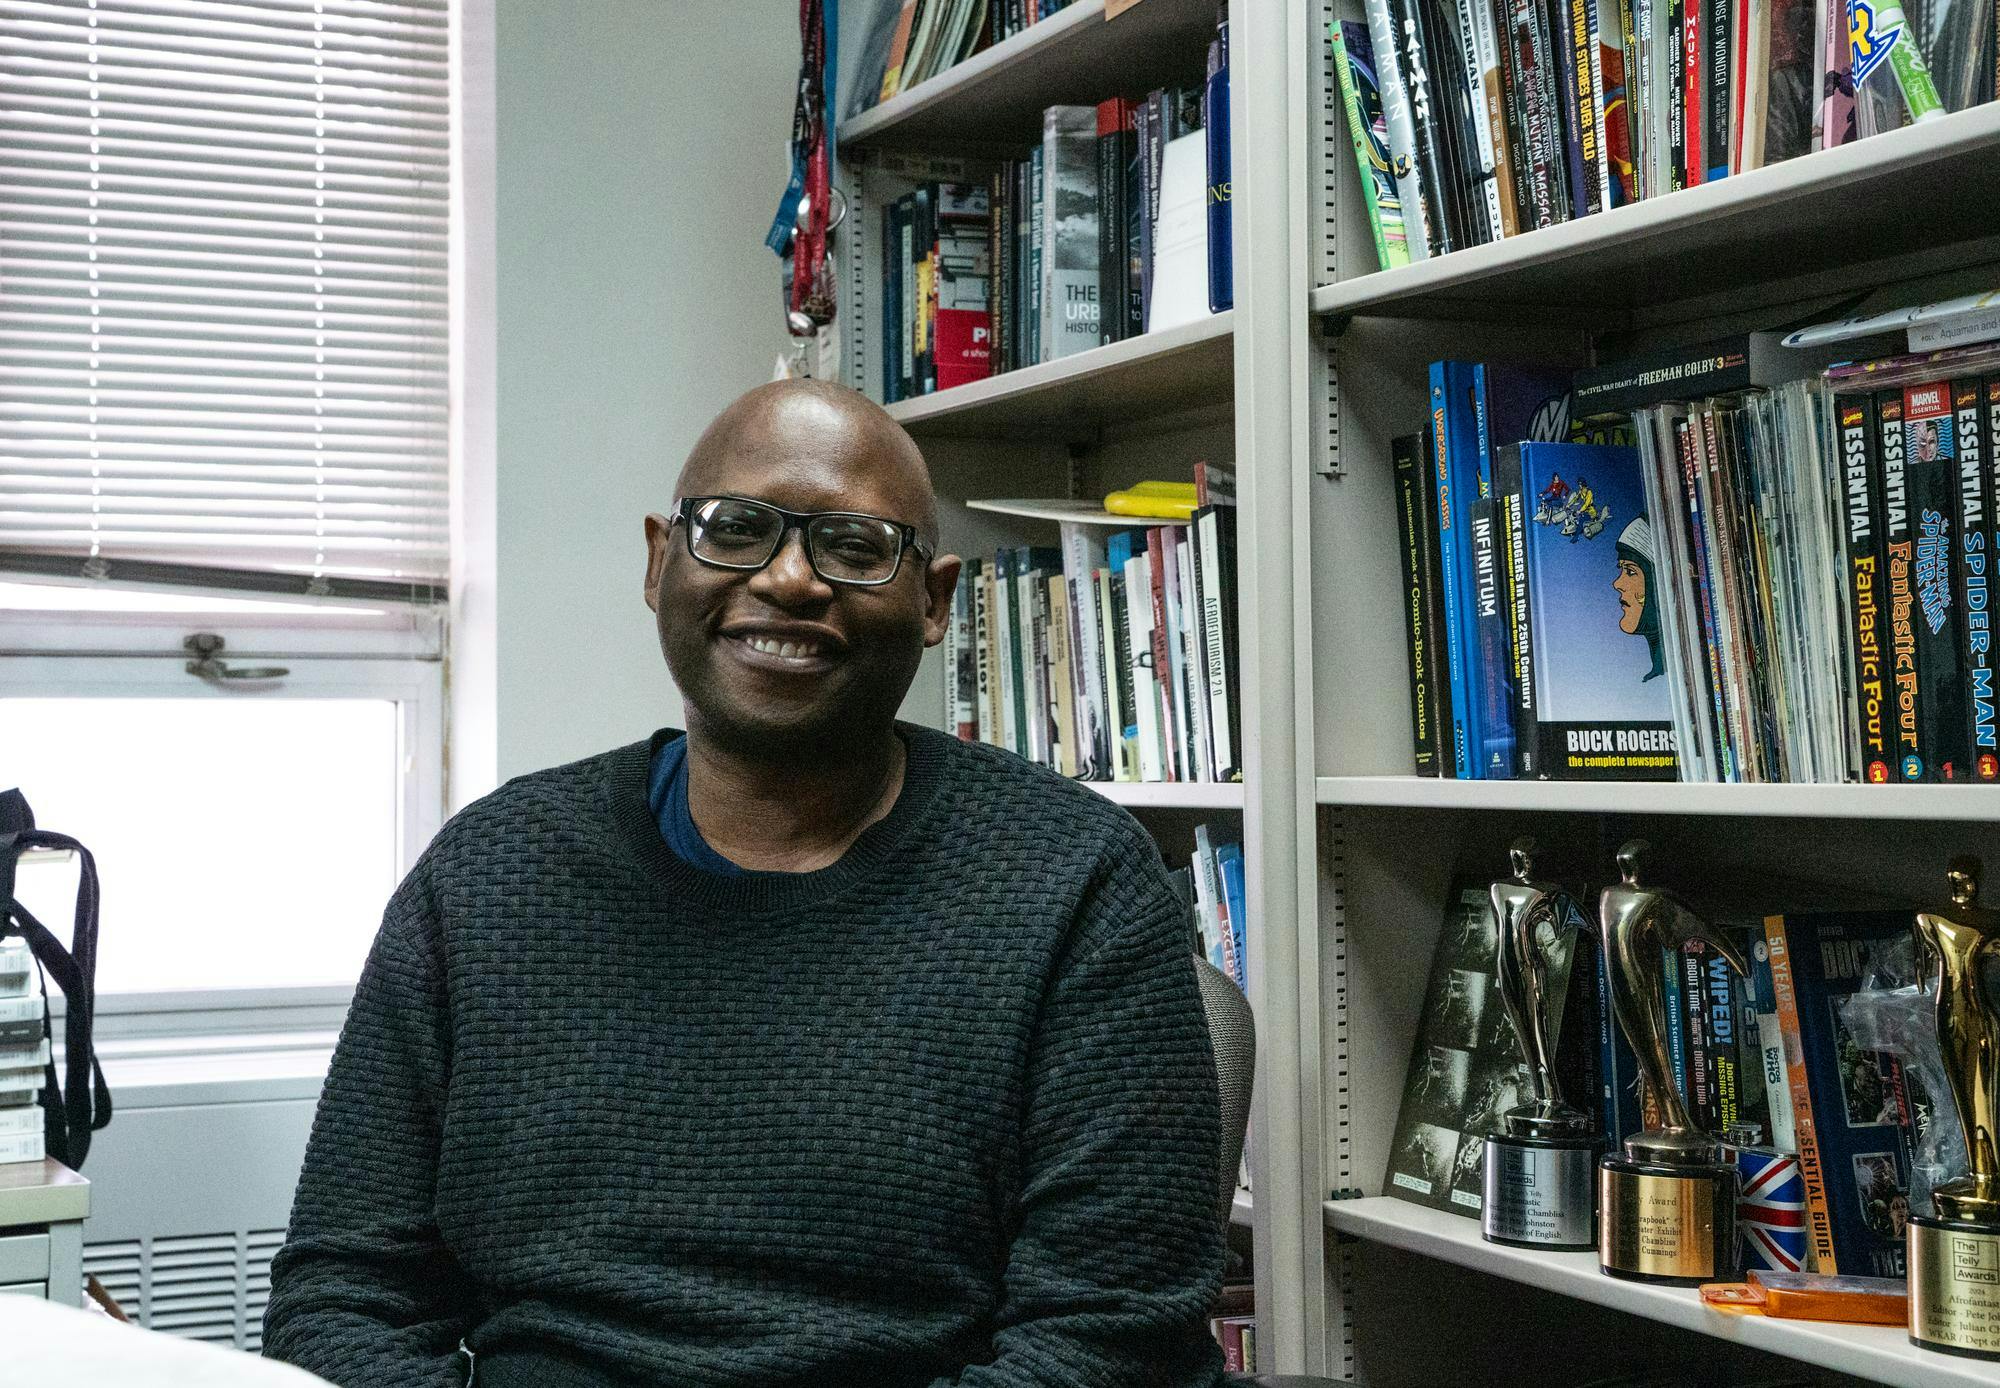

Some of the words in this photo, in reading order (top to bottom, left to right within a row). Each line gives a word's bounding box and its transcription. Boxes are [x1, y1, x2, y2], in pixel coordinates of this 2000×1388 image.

[1511, 17, 1519, 35] RED
[1572, 0, 1588, 47] BATMAN
[1641, 10, 1652, 41] COMICS
[1715, 0, 1727, 23] NSE
[1513, 40, 1521, 51] NO
[1686, 16, 1698, 68] MAUS
[1715, 25, 1725, 36] OF
[1336, 50, 1350, 91] SUPERMAN
[1403, 19, 1430, 119] BATMAN
[1515, 52, 1525, 83] QUARTER
[1575, 48, 1591, 97] STORIES
[1715, 38, 1727, 87] WONDER
[1506, 92, 1517, 127] JOYRIDE
[1579, 98, 1594, 129] EVER
[1512, 142, 1522, 171] DIGGLE
[1528, 114, 1545, 168] MUTANT
[1582, 131, 1597, 161] TOLD
[1150, 137, 1159, 189] Rebuilding
[1151, 189, 1159, 219] Urban
[1516, 175, 1526, 206] MANCO
[1065, 284, 1097, 302] THE
[1940, 324, 1980, 341] Aquaman
[1980, 318, 1997, 332] and
[1602, 382, 1615, 393] WAR
[1614, 378, 1633, 391] DIARY
[1638, 365, 1683, 386] FREEMAN
[1684, 358, 1715, 378] COLBY
[1716, 356, 1724, 370] 3
[1910, 391, 1940, 407] MARVEL
[1910, 404, 1941, 415] ESSENTIAL
[1475, 400, 1485, 433] JAMAL
[1433, 407, 1449, 482] UNDERGROUND
[1478, 435, 1487, 457] IGLE
[1884, 420, 1908, 536] ESSENTIAL
[1957, 408, 1984, 527] ESSENTIAL
[1844, 426, 1871, 543] ESSENTIAL
[1405, 488, 1418, 547] Smithsonian
[1440, 484, 1451, 531] CLASSICS
[1509, 493, 1521, 528] BUCK
[1411, 548, 1419, 571] Book
[1474, 516, 1497, 618] INFINITUM
[1506, 540, 1516, 577] newspaper
[1512, 530, 1525, 583] ROGERS
[1917, 507, 1945, 636] SPIDER-MAN
[1934, 532, 1954, 608] AMAZING
[1412, 573, 1420, 585] of
[976, 586, 990, 642] RACE
[1516, 597, 1527, 622] the
[1854, 555, 1880, 675] Fantastic
[1888, 540, 1916, 669] Fantastic
[1205, 596, 1222, 677] AFROFUTURISM
[1411, 587, 1427, 680] Comic-Book
[1518, 623, 1530, 655] 25th
[1962, 530, 1997, 747] SPIDER-MAN
[978, 647, 989, 696] RIOT
[1520, 657, 1532, 709] Century
[1212, 679, 1223, 697] 2.0
[1417, 683, 1429, 741] Comics
[1864, 675, 1885, 752] Four
[1897, 669, 1918, 749] Four
[1566, 730, 1615, 752] BUCK
[1616, 730, 1680, 752] ROGERS
[1568, 755, 1584, 767] the
[1584, 755, 1626, 768] complete
[1626, 755, 1675, 768] newspaper
[1873, 769, 1884, 783] 1
[1907, 764, 1918, 776] 2
[1942, 762, 1953, 779] 1
[1983, 763, 1994, 776] 1
[1769, 935, 1784, 957] 50
[1686, 958, 1698, 988] ABOUT
[1774, 961, 1793, 1013] YEARS
[1598, 976, 1608, 1014] DOCTOR
[1668, 995, 1680, 1025] British
[1689, 988, 1701, 1012] TIME
[1708, 955, 1734, 1045] WIPED!
[1600, 1019, 1609, 1045] WHO
[1671, 1026, 1682, 1060] Science
[1693, 1050, 1704, 1082] DOCTOR
[1718, 1056, 1728, 1095] MISSING
[1764, 1046, 1775, 1084] WHO
[1772, 1046, 1782, 1082] DOCTOR
[1695, 1083, 1707, 1106] WHO
[1726, 1062, 1738, 1100] DOCTOR
[1527, 1209, 1565, 1219] Chambliss
[1647, 1195, 1678, 1207] Award
[1525, 1219, 1556, 1229] Johnston
[1535, 1229, 1563, 1240] English
[1657, 1225, 1683, 1237] Exhibit
[1812, 1209, 1832, 1259] GUIDE
[1641, 1235, 1677, 1247] Chambliss
[1641, 1245, 1678, 1259] Cummings
[1956, 1240, 1976, 1252] The
[1957, 1255, 1980, 1267] Telly
[1957, 1269, 1997, 1282] Awards
[1931, 1304, 1957, 1317] Editor
[1966, 1309, 1986, 1321] Pete
[1958, 1321, 1986, 1334] Julian
[1928, 1329, 1957, 1342] WKAR
[1965, 1334, 1989, 1348] Dept
